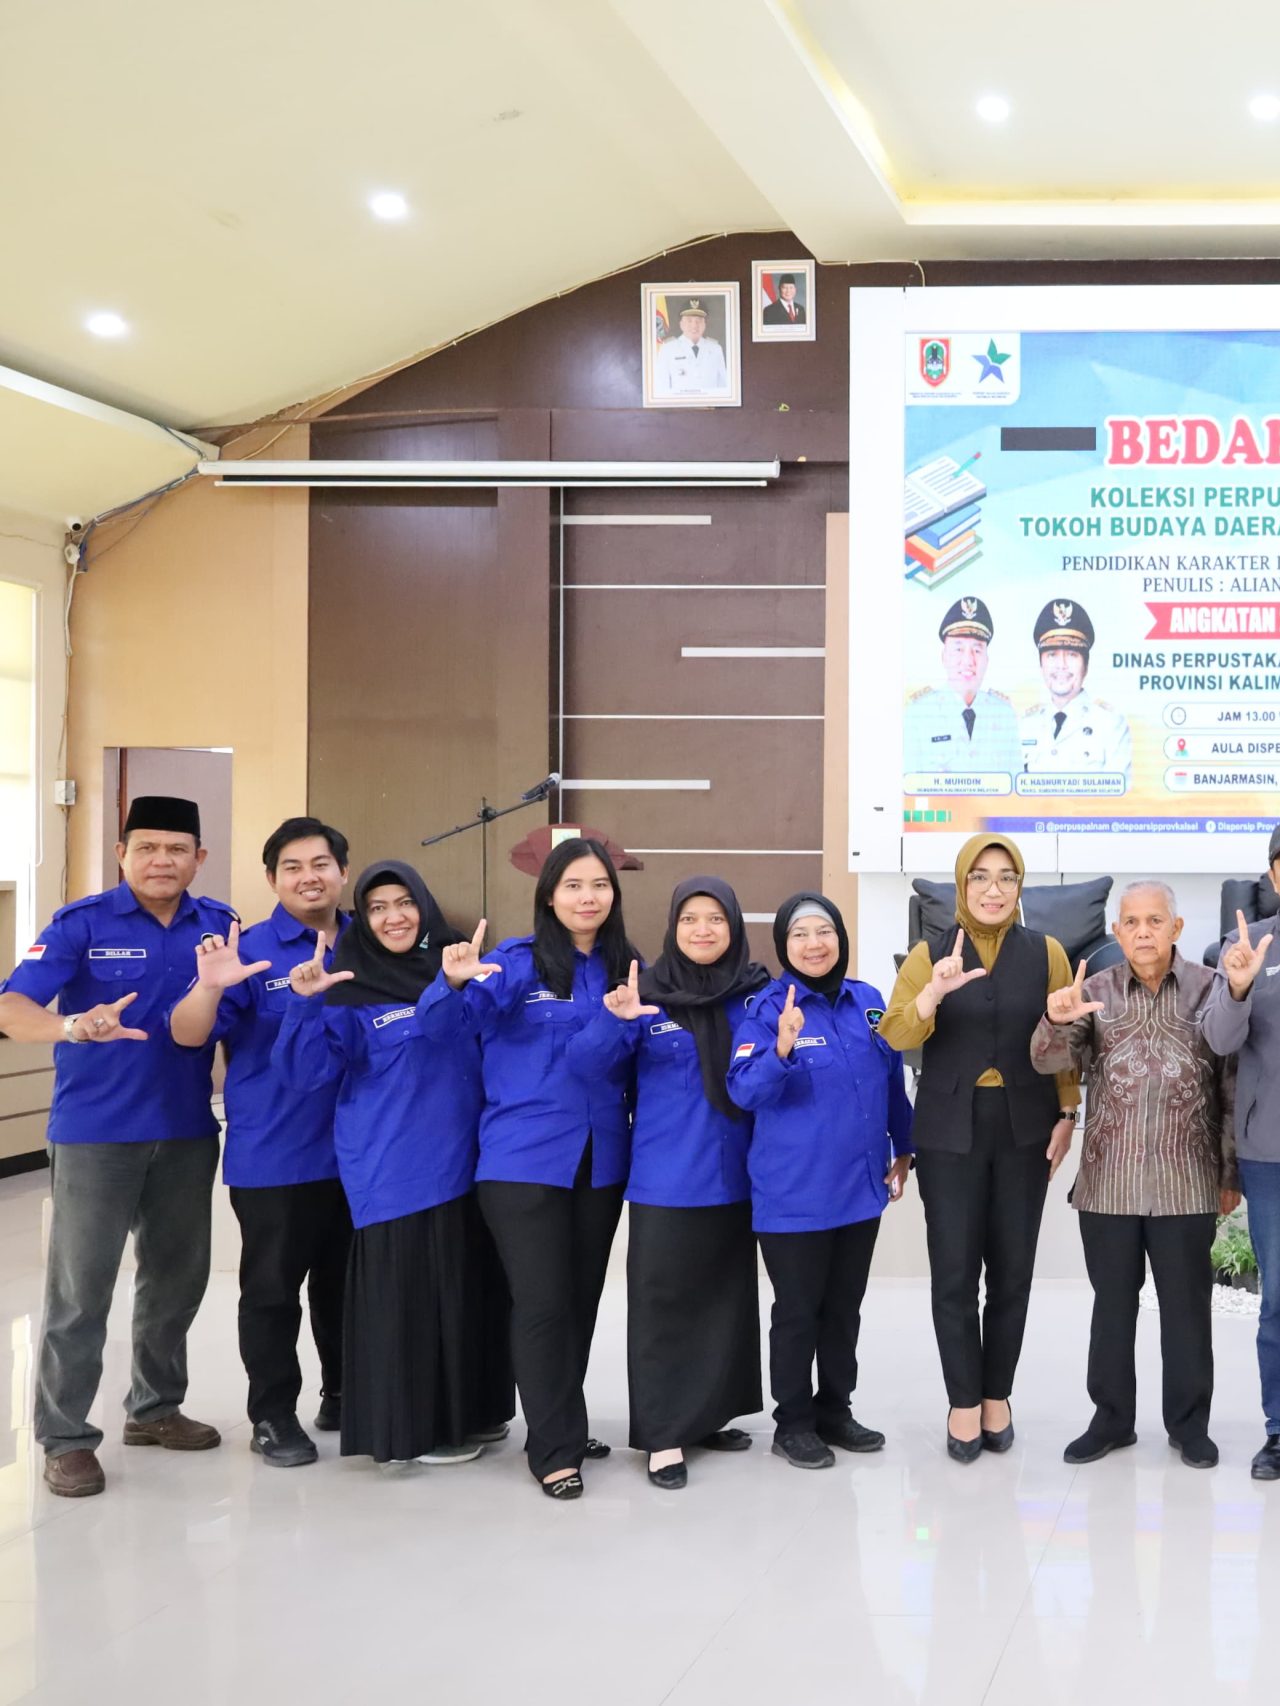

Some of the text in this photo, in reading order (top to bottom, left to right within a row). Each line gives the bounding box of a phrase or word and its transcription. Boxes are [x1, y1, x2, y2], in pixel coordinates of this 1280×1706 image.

[1090, 487, 1194, 508] KOLEKSI
[1020, 517, 1102, 536] TOKOH
[1111, 517, 1205, 536] BUDAYA
[1062, 556, 1168, 571] PENDIDIKAN
[1177, 556, 1270, 571] KARAKTER
[1143, 577, 1213, 592] PENULIS
[1170, 608, 1275, 633] ANGKATAN
[1113, 653, 1165, 668] DINAS
[1140, 676, 1222, 690] PROVINSI
[1217, 711, 1241, 721] JAM
[1246, 711, 1274, 721] 13.00
[1212, 743, 1243, 753] AULA
[1194, 774, 1278, 786] BANJARMASIN,
